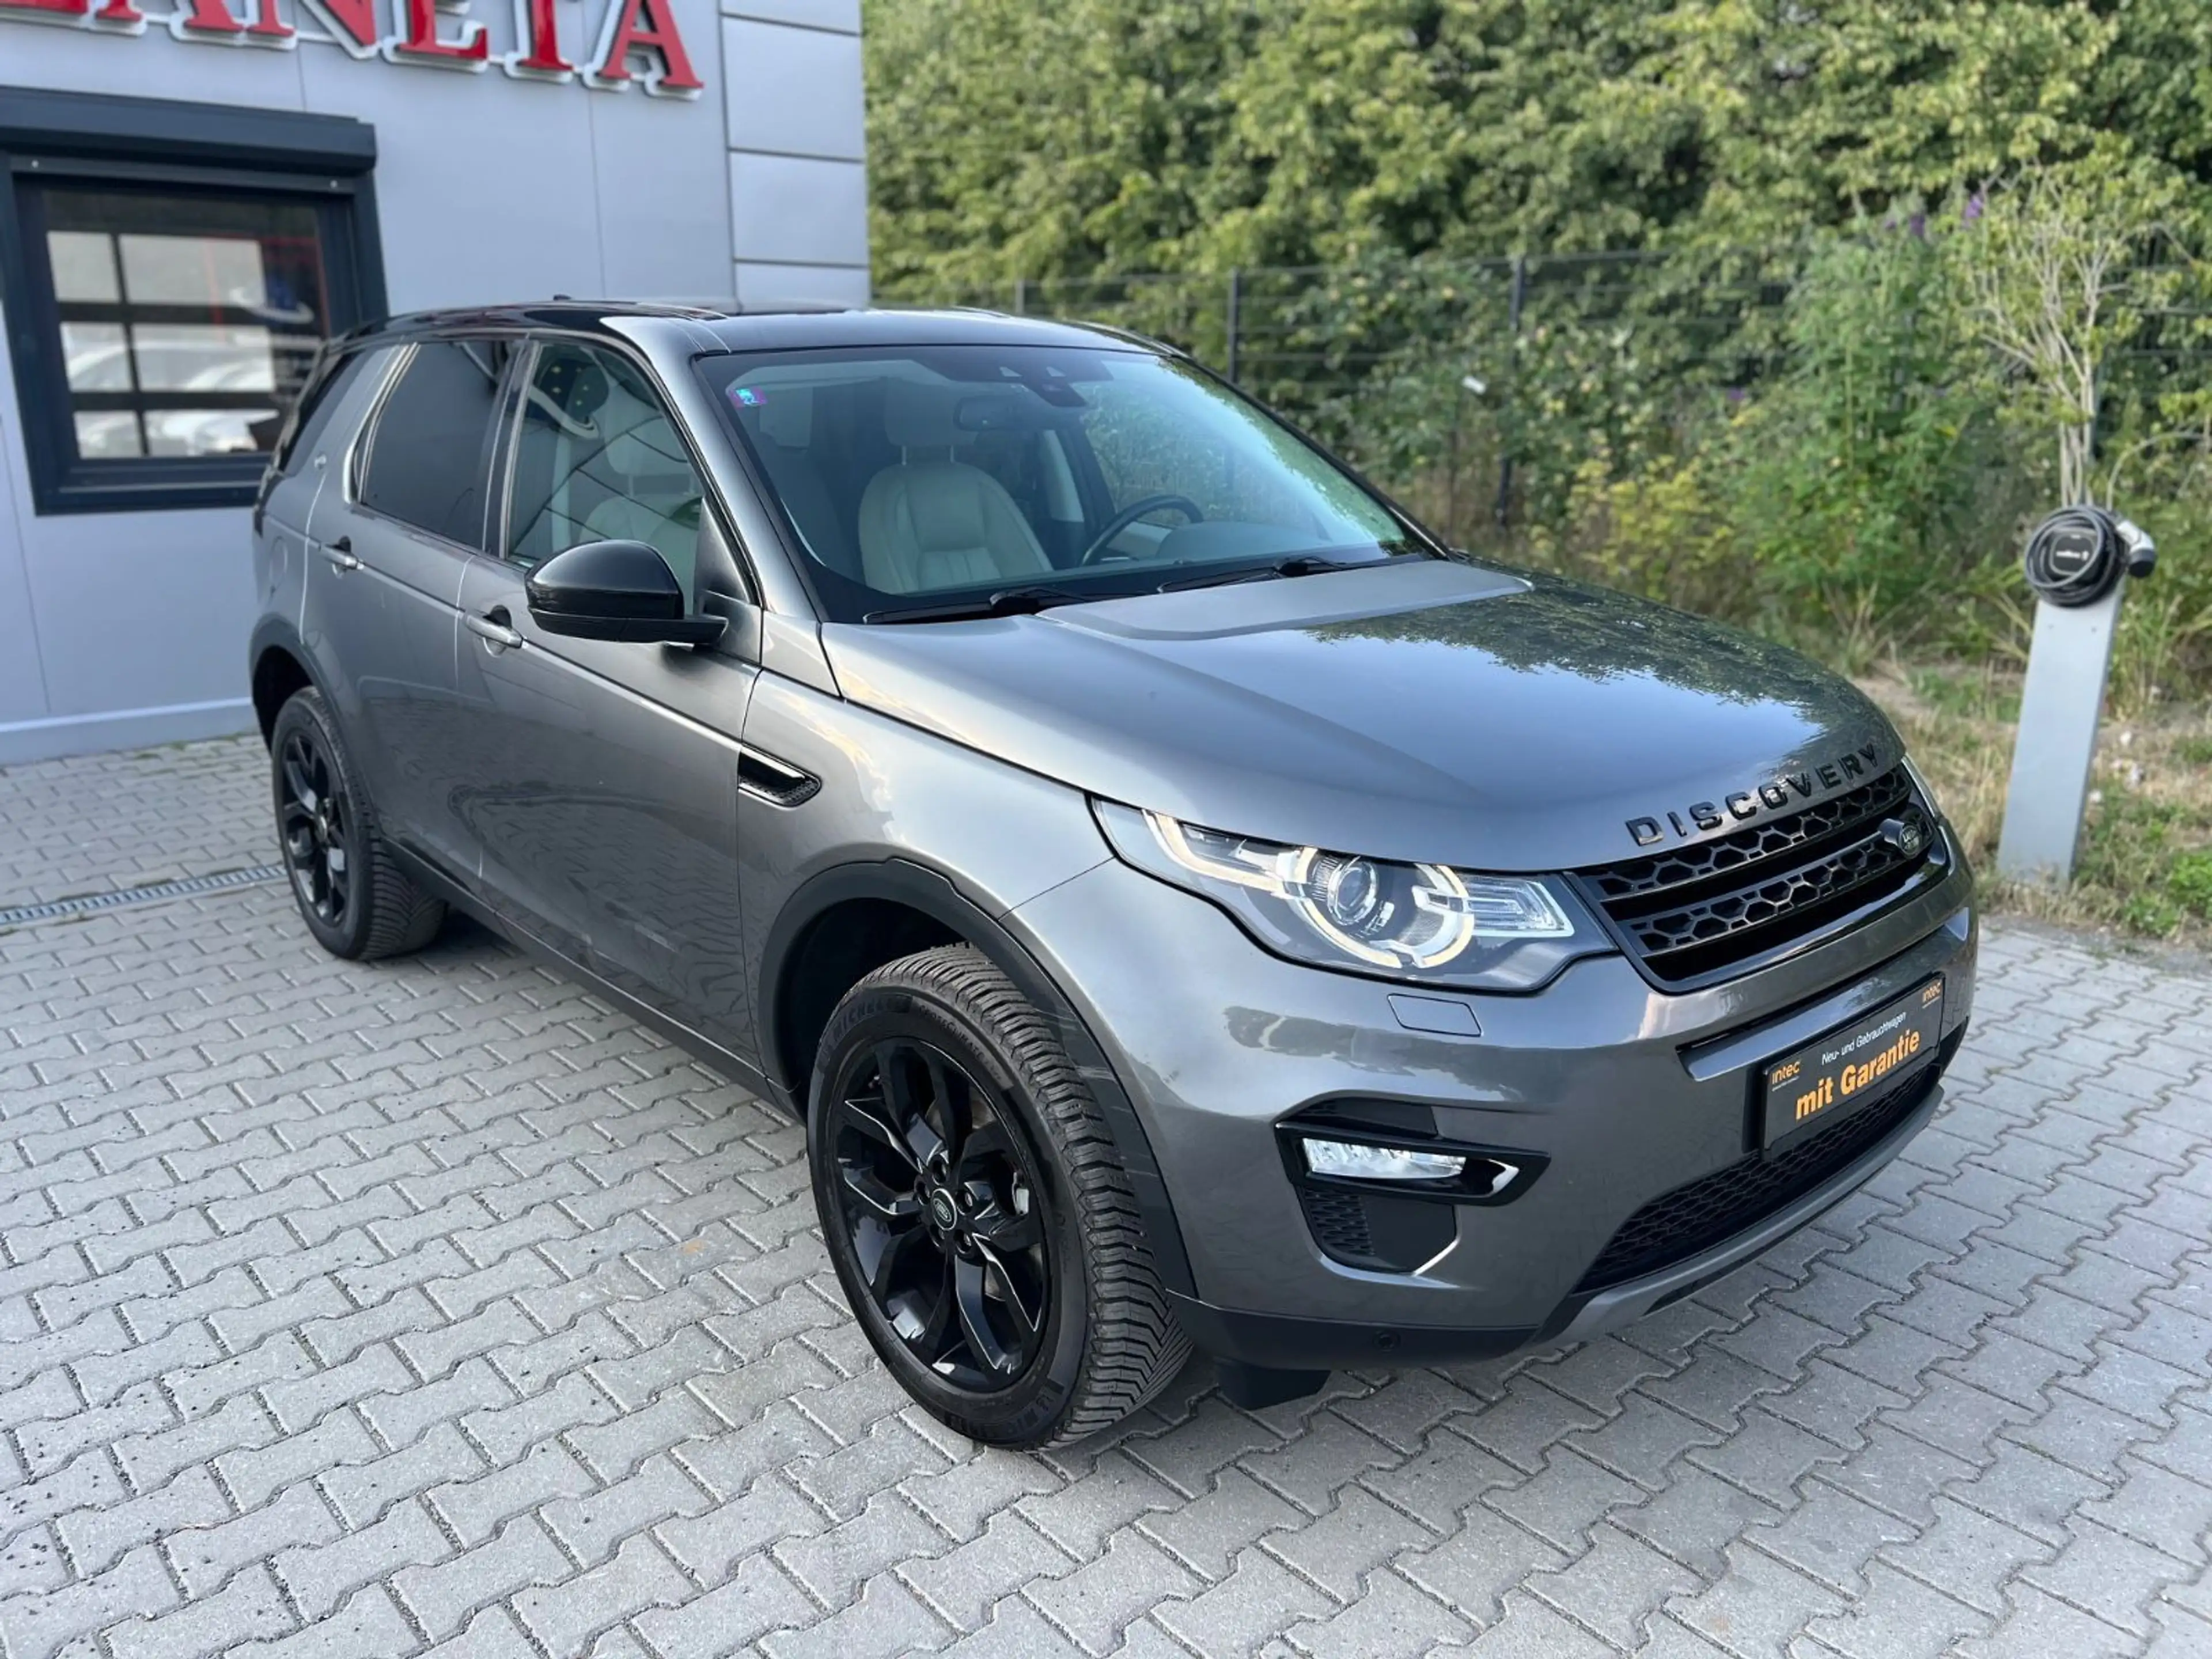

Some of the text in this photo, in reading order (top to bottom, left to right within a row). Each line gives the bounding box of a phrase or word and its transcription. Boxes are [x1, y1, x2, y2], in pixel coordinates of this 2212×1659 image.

[1625, 743, 1879, 847] DISCOVERY
[1796, 1028, 1921, 1120] mit Garantie
[1821, 1012, 1907, 1066] Neu- und Gebrauchtwagen
